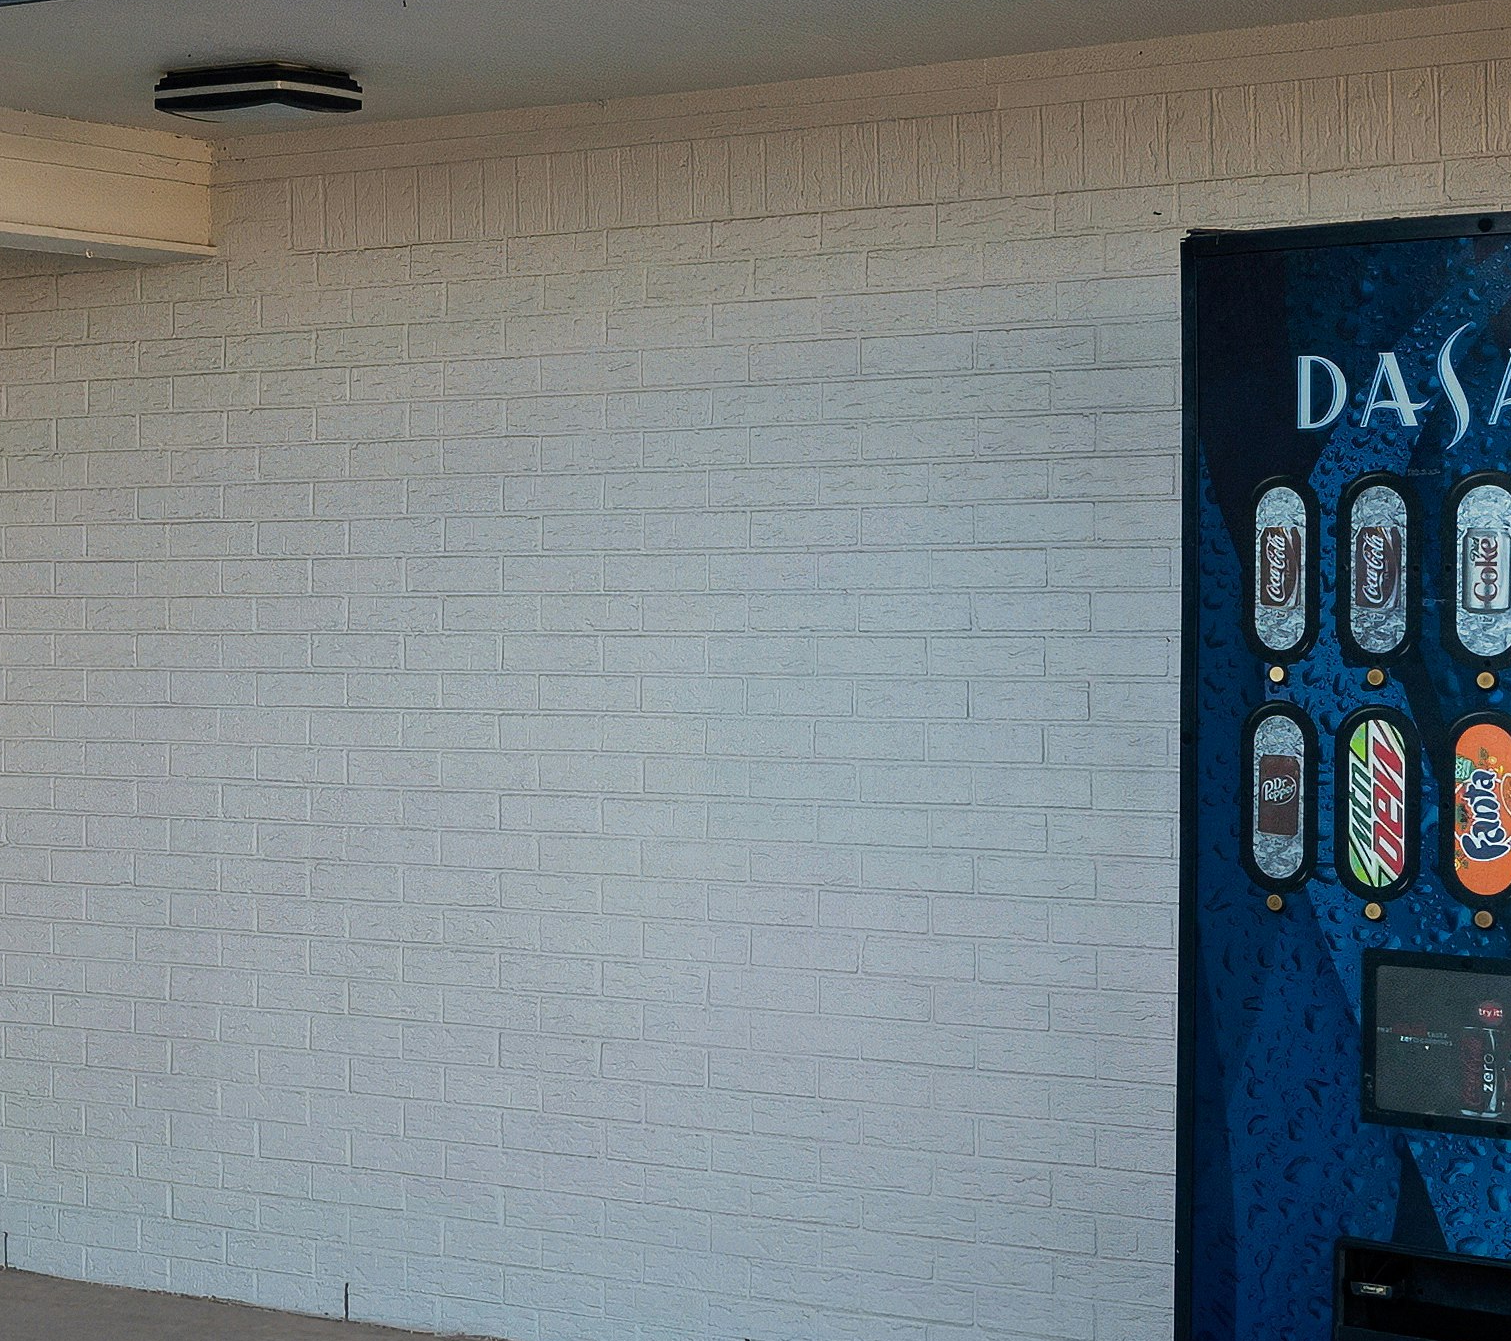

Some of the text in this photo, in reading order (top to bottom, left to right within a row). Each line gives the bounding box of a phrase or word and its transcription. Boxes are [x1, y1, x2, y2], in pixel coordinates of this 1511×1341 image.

[1474, 536, 1498, 601] Coke
[1262, 778, 1296, 802] Pepper
[1273, 777, 1288, 792] Dr
[1460, 769, 1511, 861] Fanta
[1478, 1008, 1503, 1017] try it!
[1484, 1053, 1495, 1092] zero
